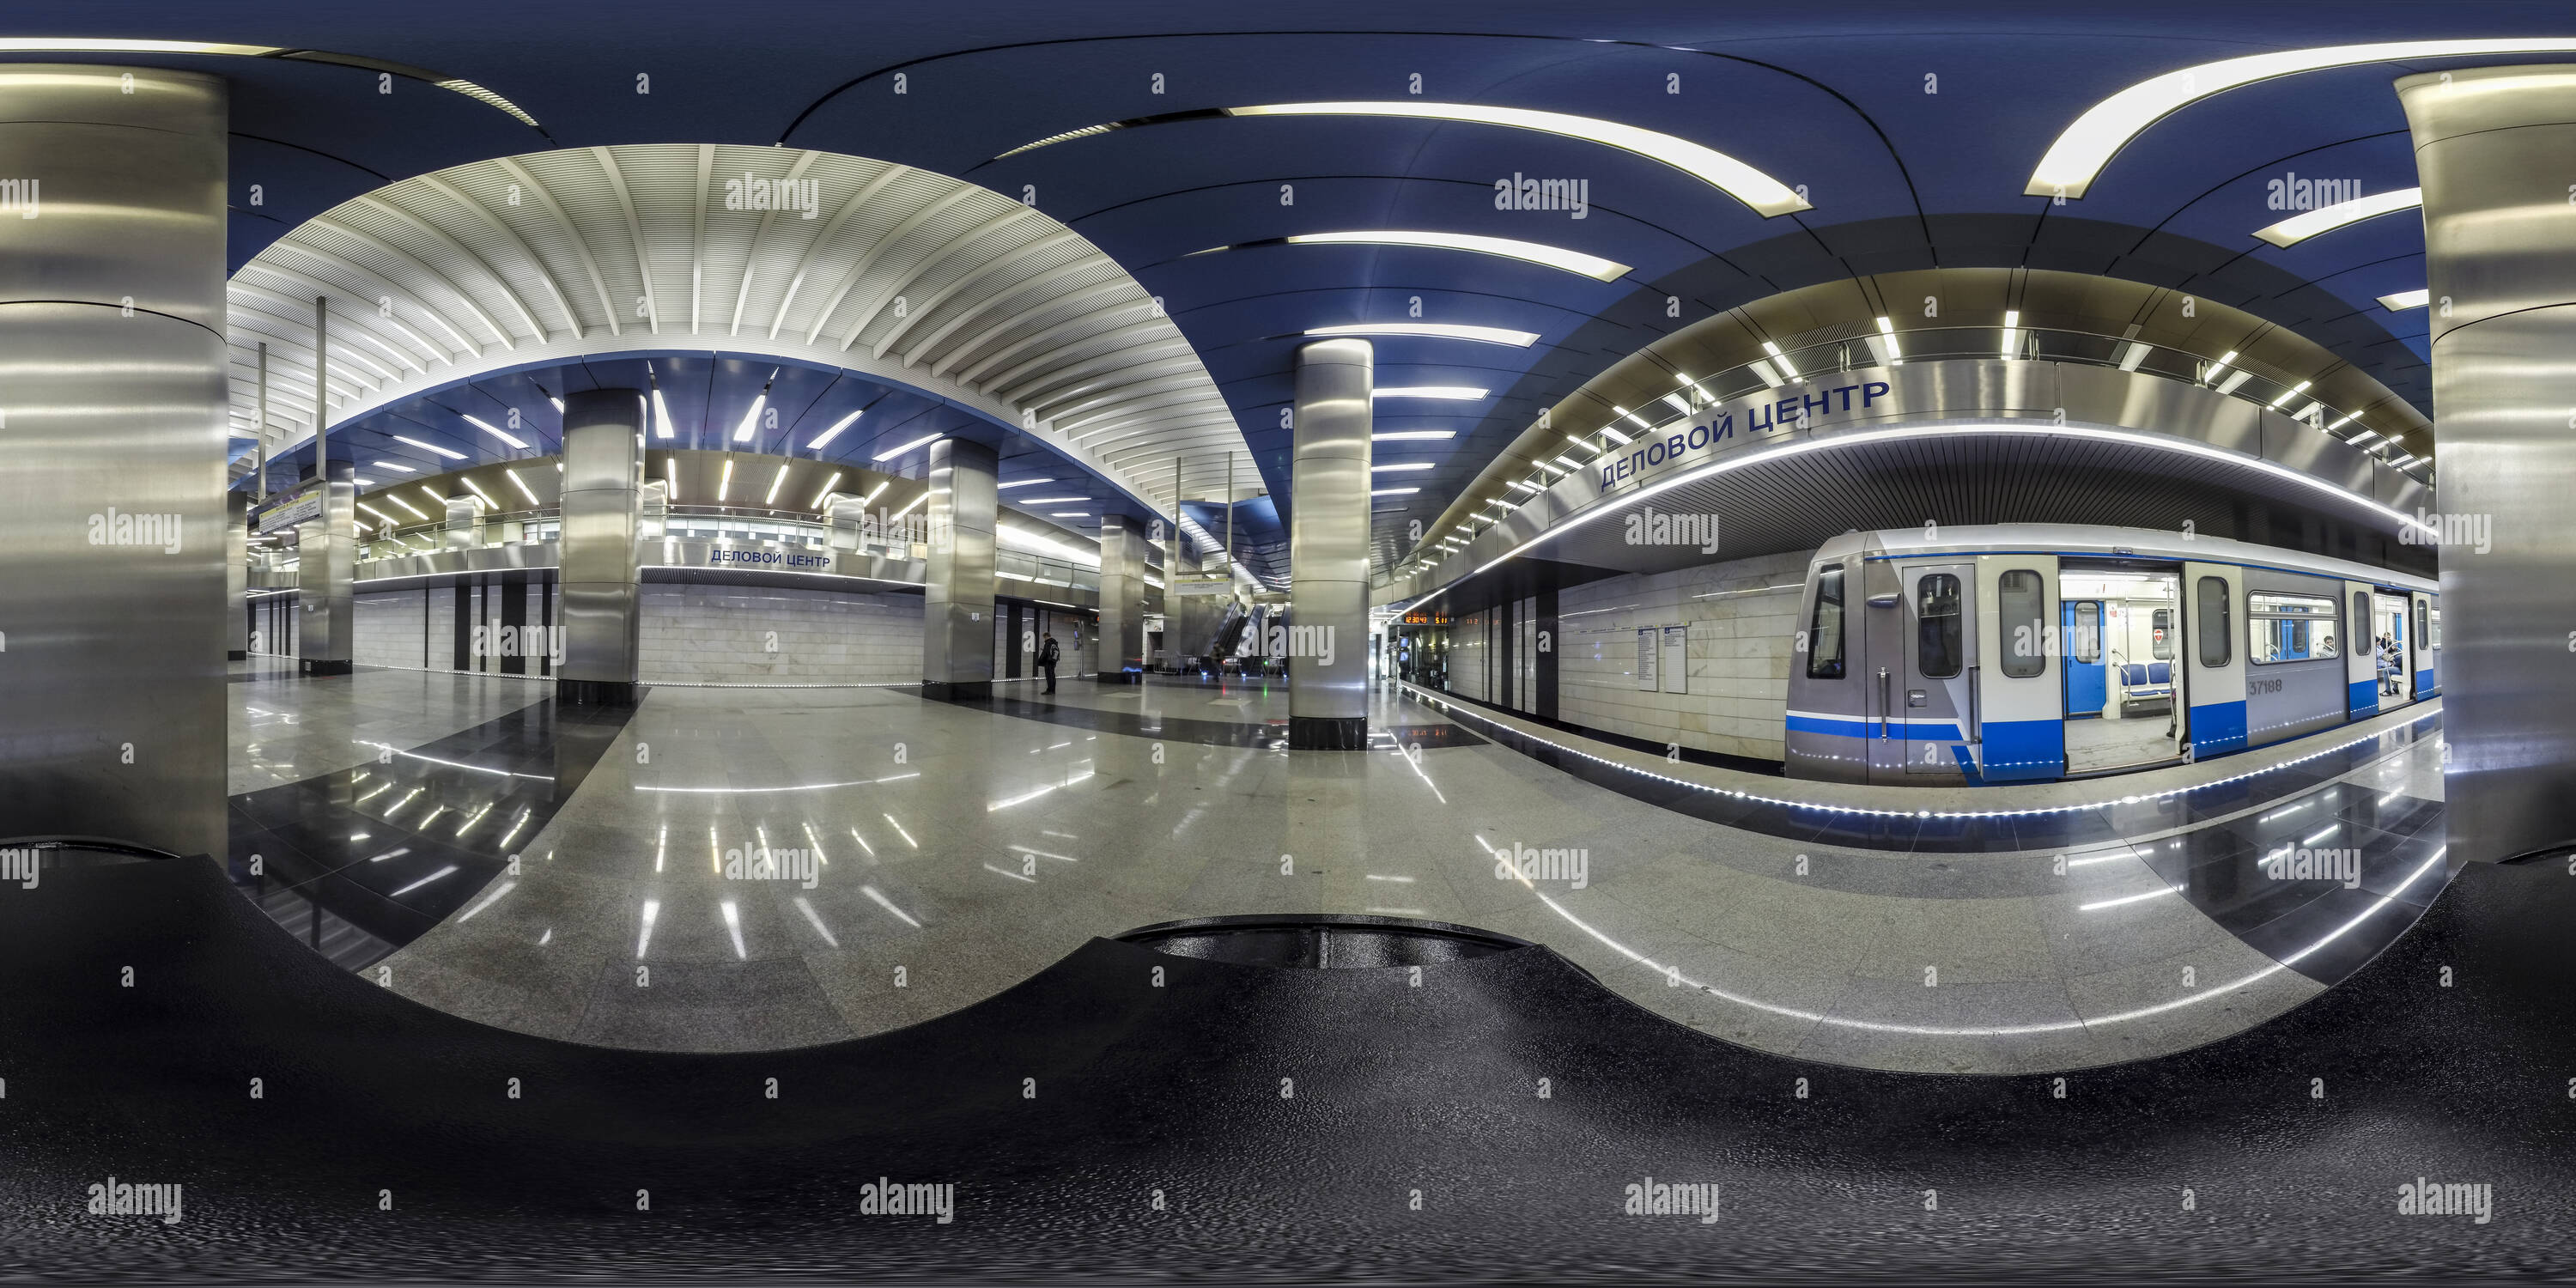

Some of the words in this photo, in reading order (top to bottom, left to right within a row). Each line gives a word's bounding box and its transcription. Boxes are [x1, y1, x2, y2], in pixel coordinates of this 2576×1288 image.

[1601, 411, 1733, 492] ДЕЛОВОЙ
[1749, 381, 1890, 432] ЦЕНТР
[711, 550, 781, 564] ДЕЛОВОЙ
[787, 554, 830, 567] ЦЕНТР
[2249, 678, 2282, 696] 37188
